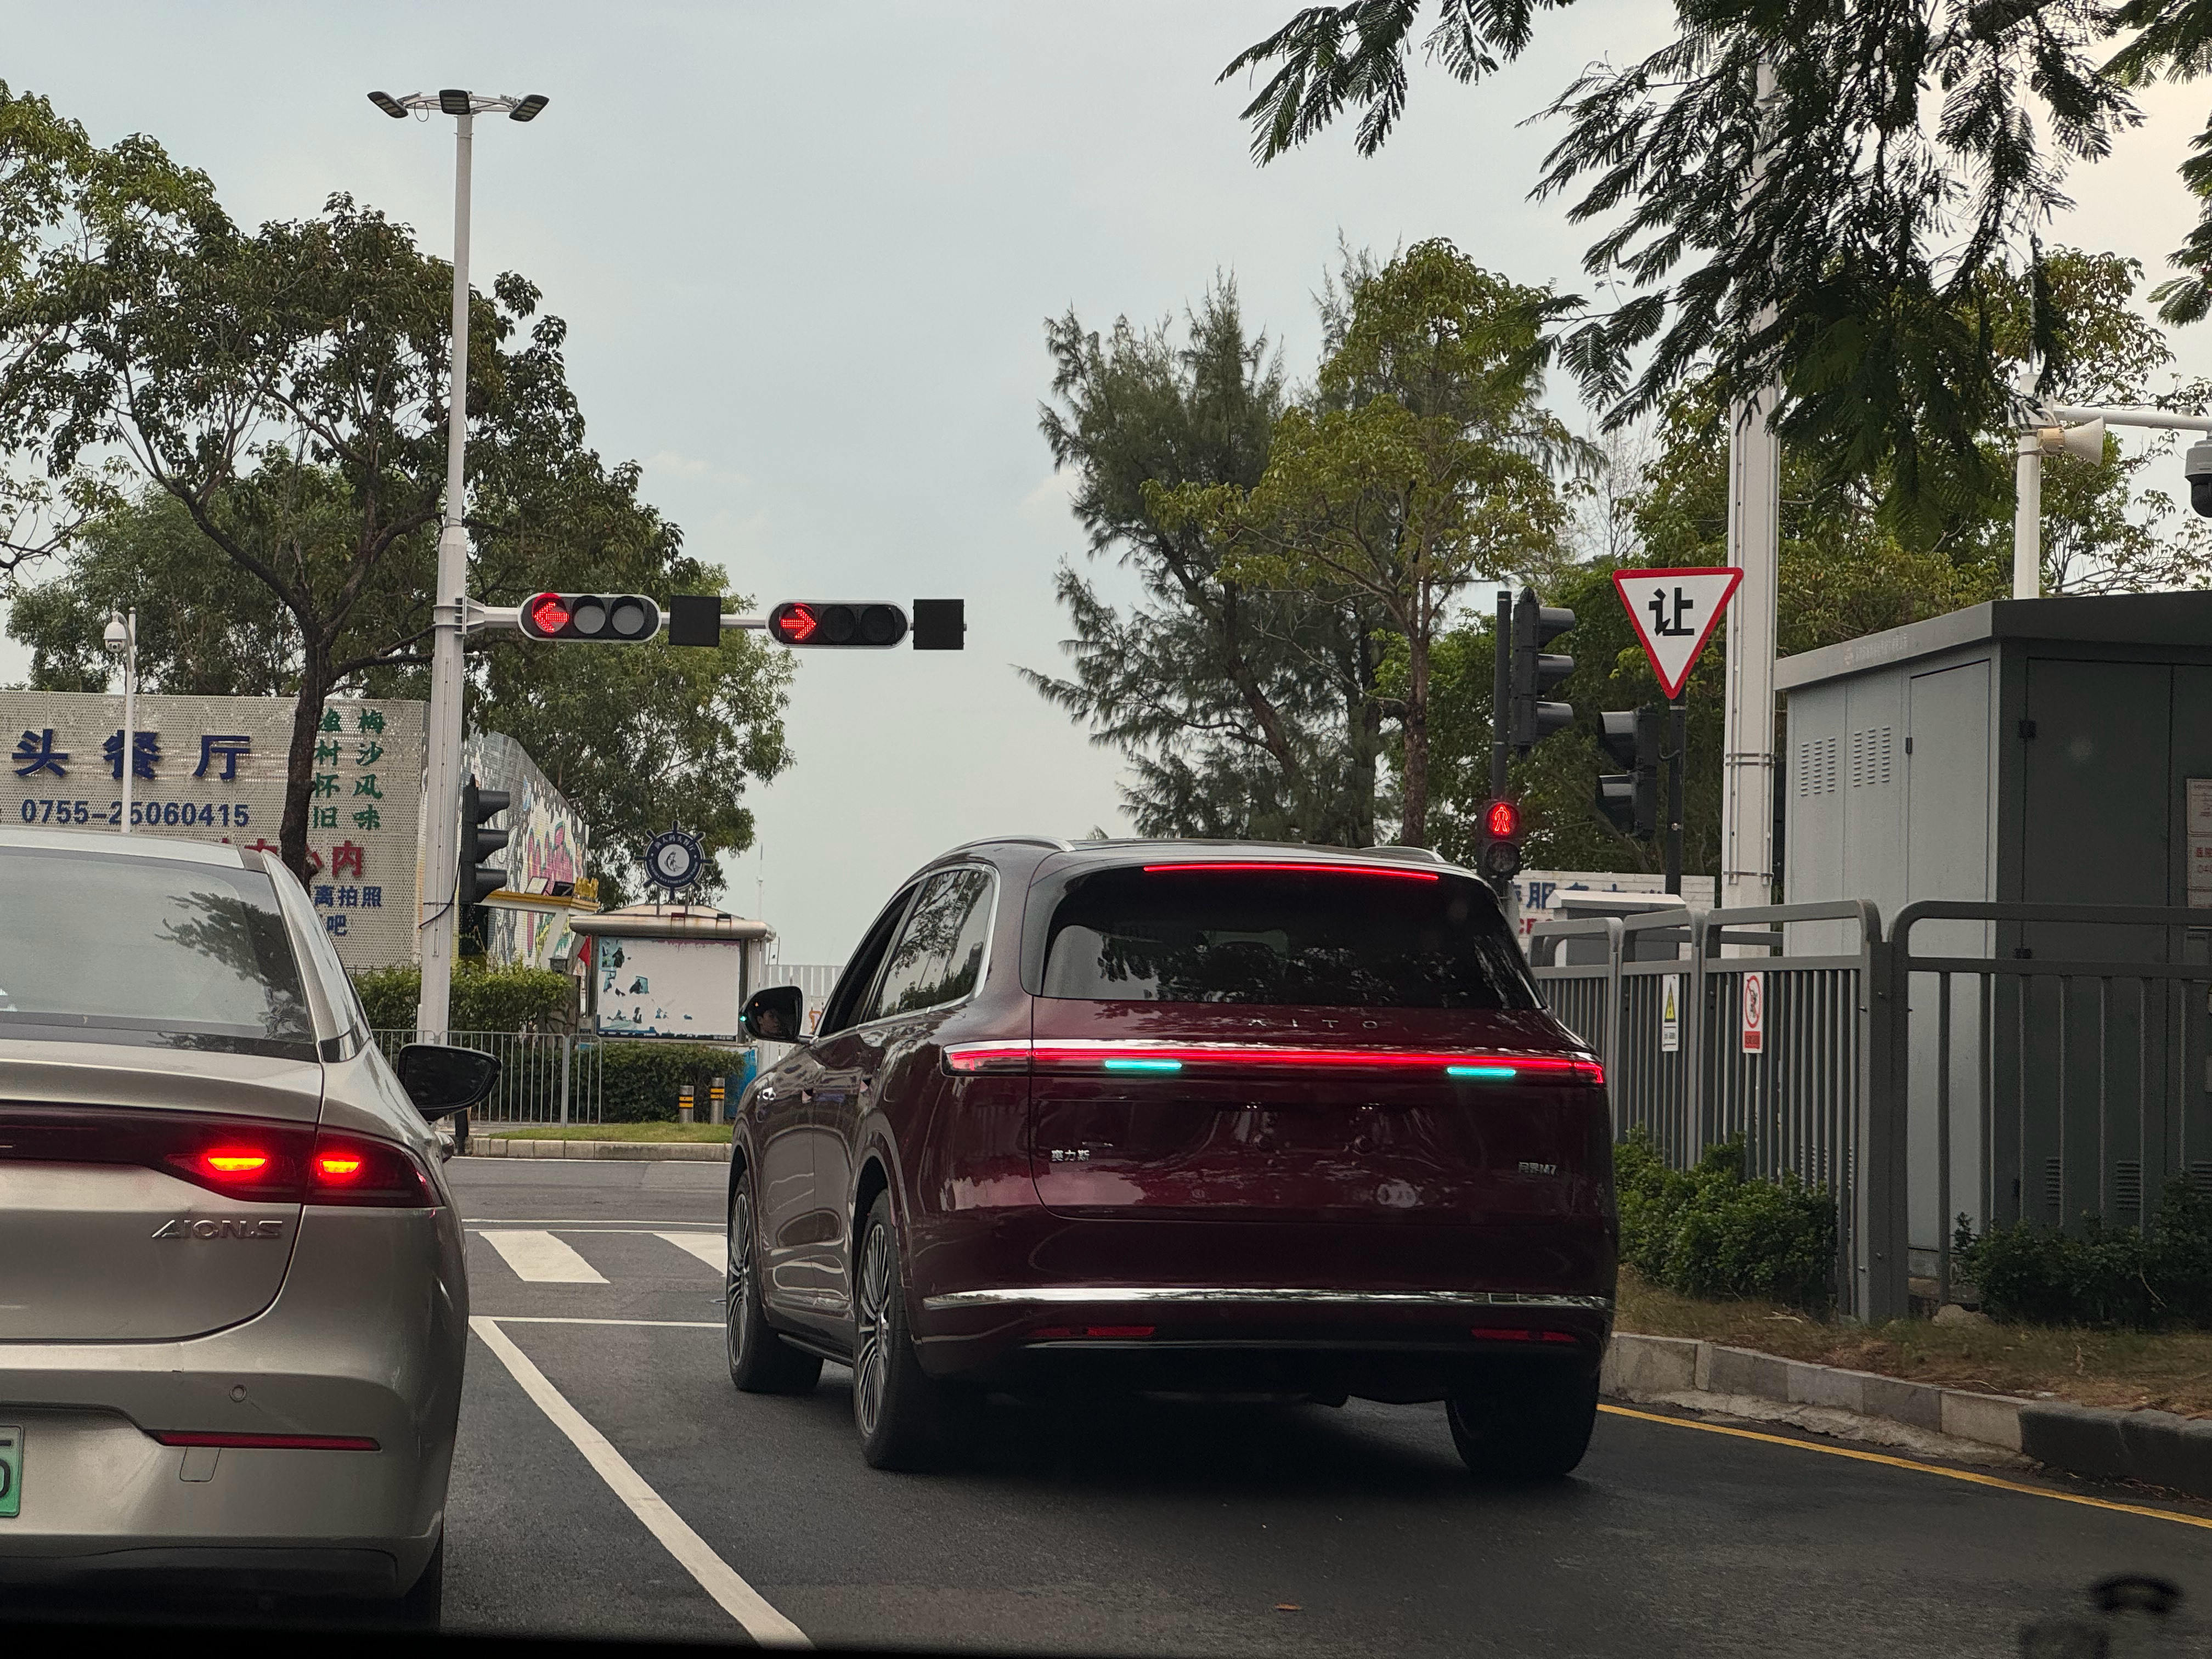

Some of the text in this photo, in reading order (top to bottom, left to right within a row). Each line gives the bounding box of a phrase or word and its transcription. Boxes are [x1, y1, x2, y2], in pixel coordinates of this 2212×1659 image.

[1649, 587, 1695, 636] 让
[12, 729, 250, 780] 头餐厅
[352, 708, 386, 831] 梅沙风味
[21, 799, 250, 827] 0755-25060415
